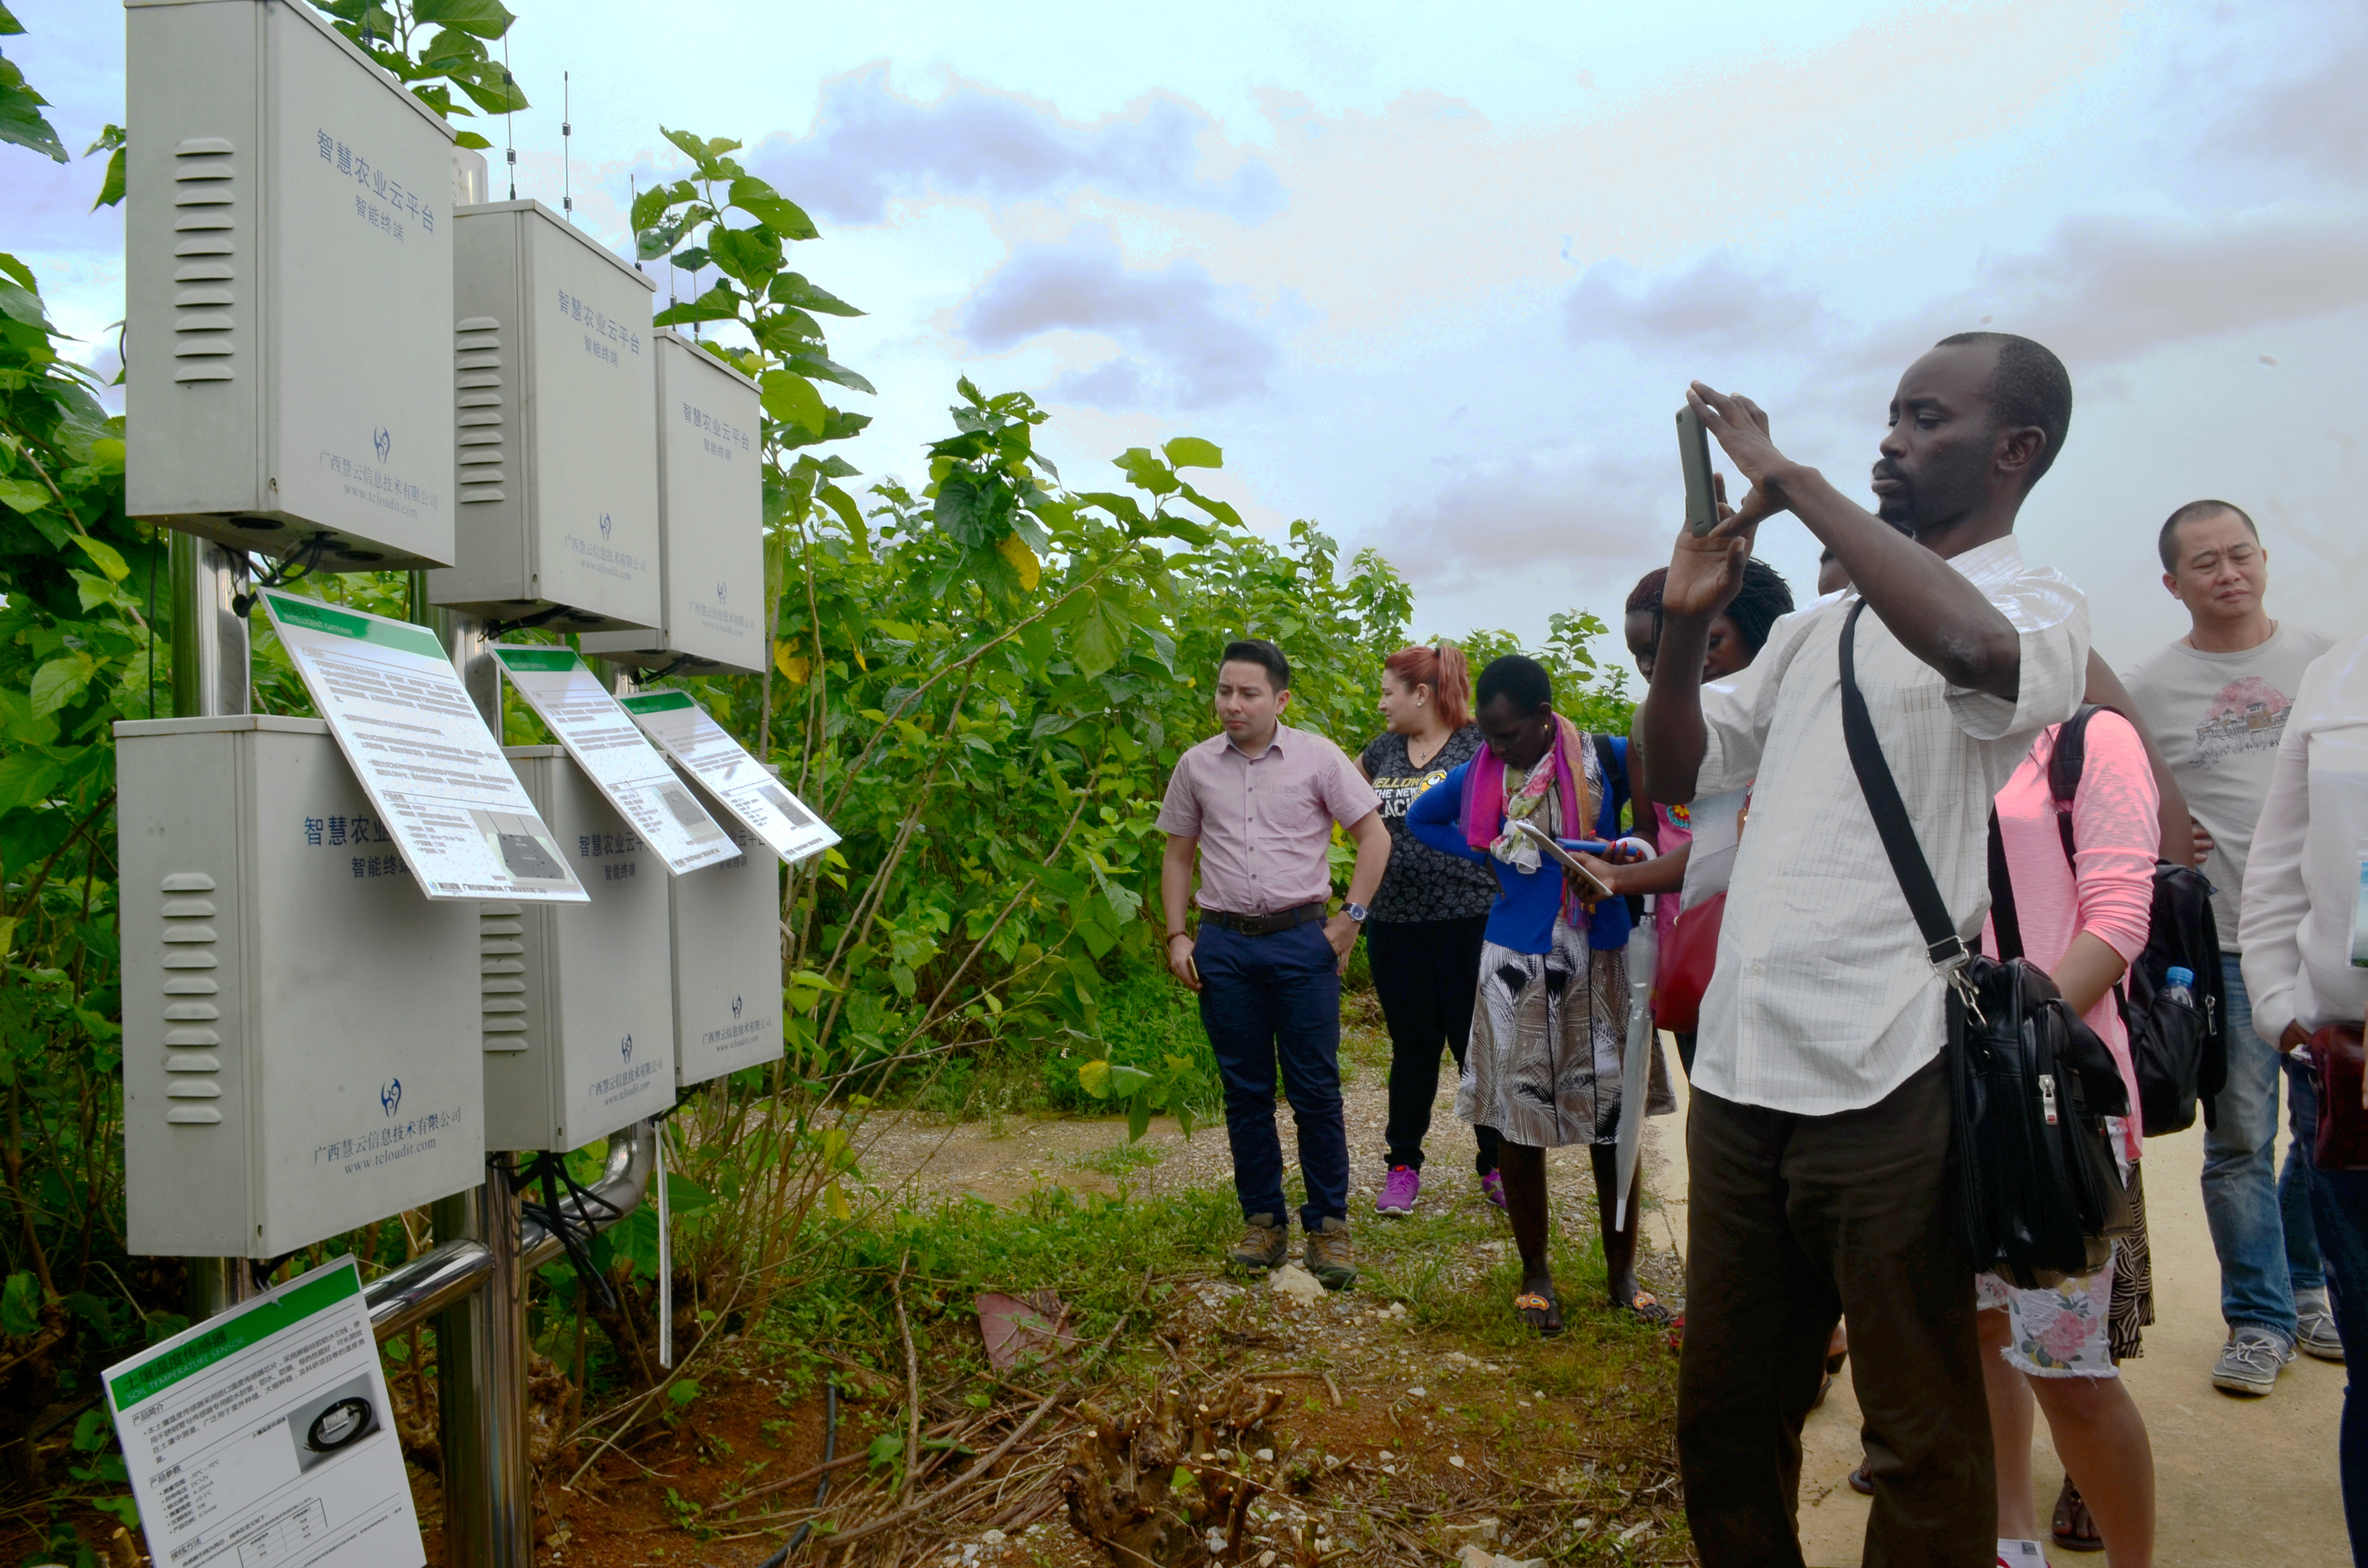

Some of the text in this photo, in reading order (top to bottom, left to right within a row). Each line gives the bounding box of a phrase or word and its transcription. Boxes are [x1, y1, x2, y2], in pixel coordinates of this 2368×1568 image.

[317, 128, 434, 234] 智慧农业云平台
[355, 194, 404, 243] 智能终端
[558, 288, 640, 355] 智慧农业云平台
[683, 402, 749, 451] 智慧农业云平台
[319, 450, 438, 510] 广西慧云信息技术有限公司
[1374, 786, 1419, 799] THE NEW
[1380, 798, 1411, 818] AC
[604, 862, 636, 881] 智能终端
[314, 1107, 462, 1165] 广西慧云信息技术有限公司
[345, 1138, 436, 1174] www.tcloudit.com
[124, 1330, 225, 1391] 土壤温度传感器
[127, 1385, 147, 1401] SOIL
[211, 1336, 245, 1358] SENSOR
[132, 1403, 164, 1424] 产品简介
[149, 1465, 181, 1486] 产品参数
